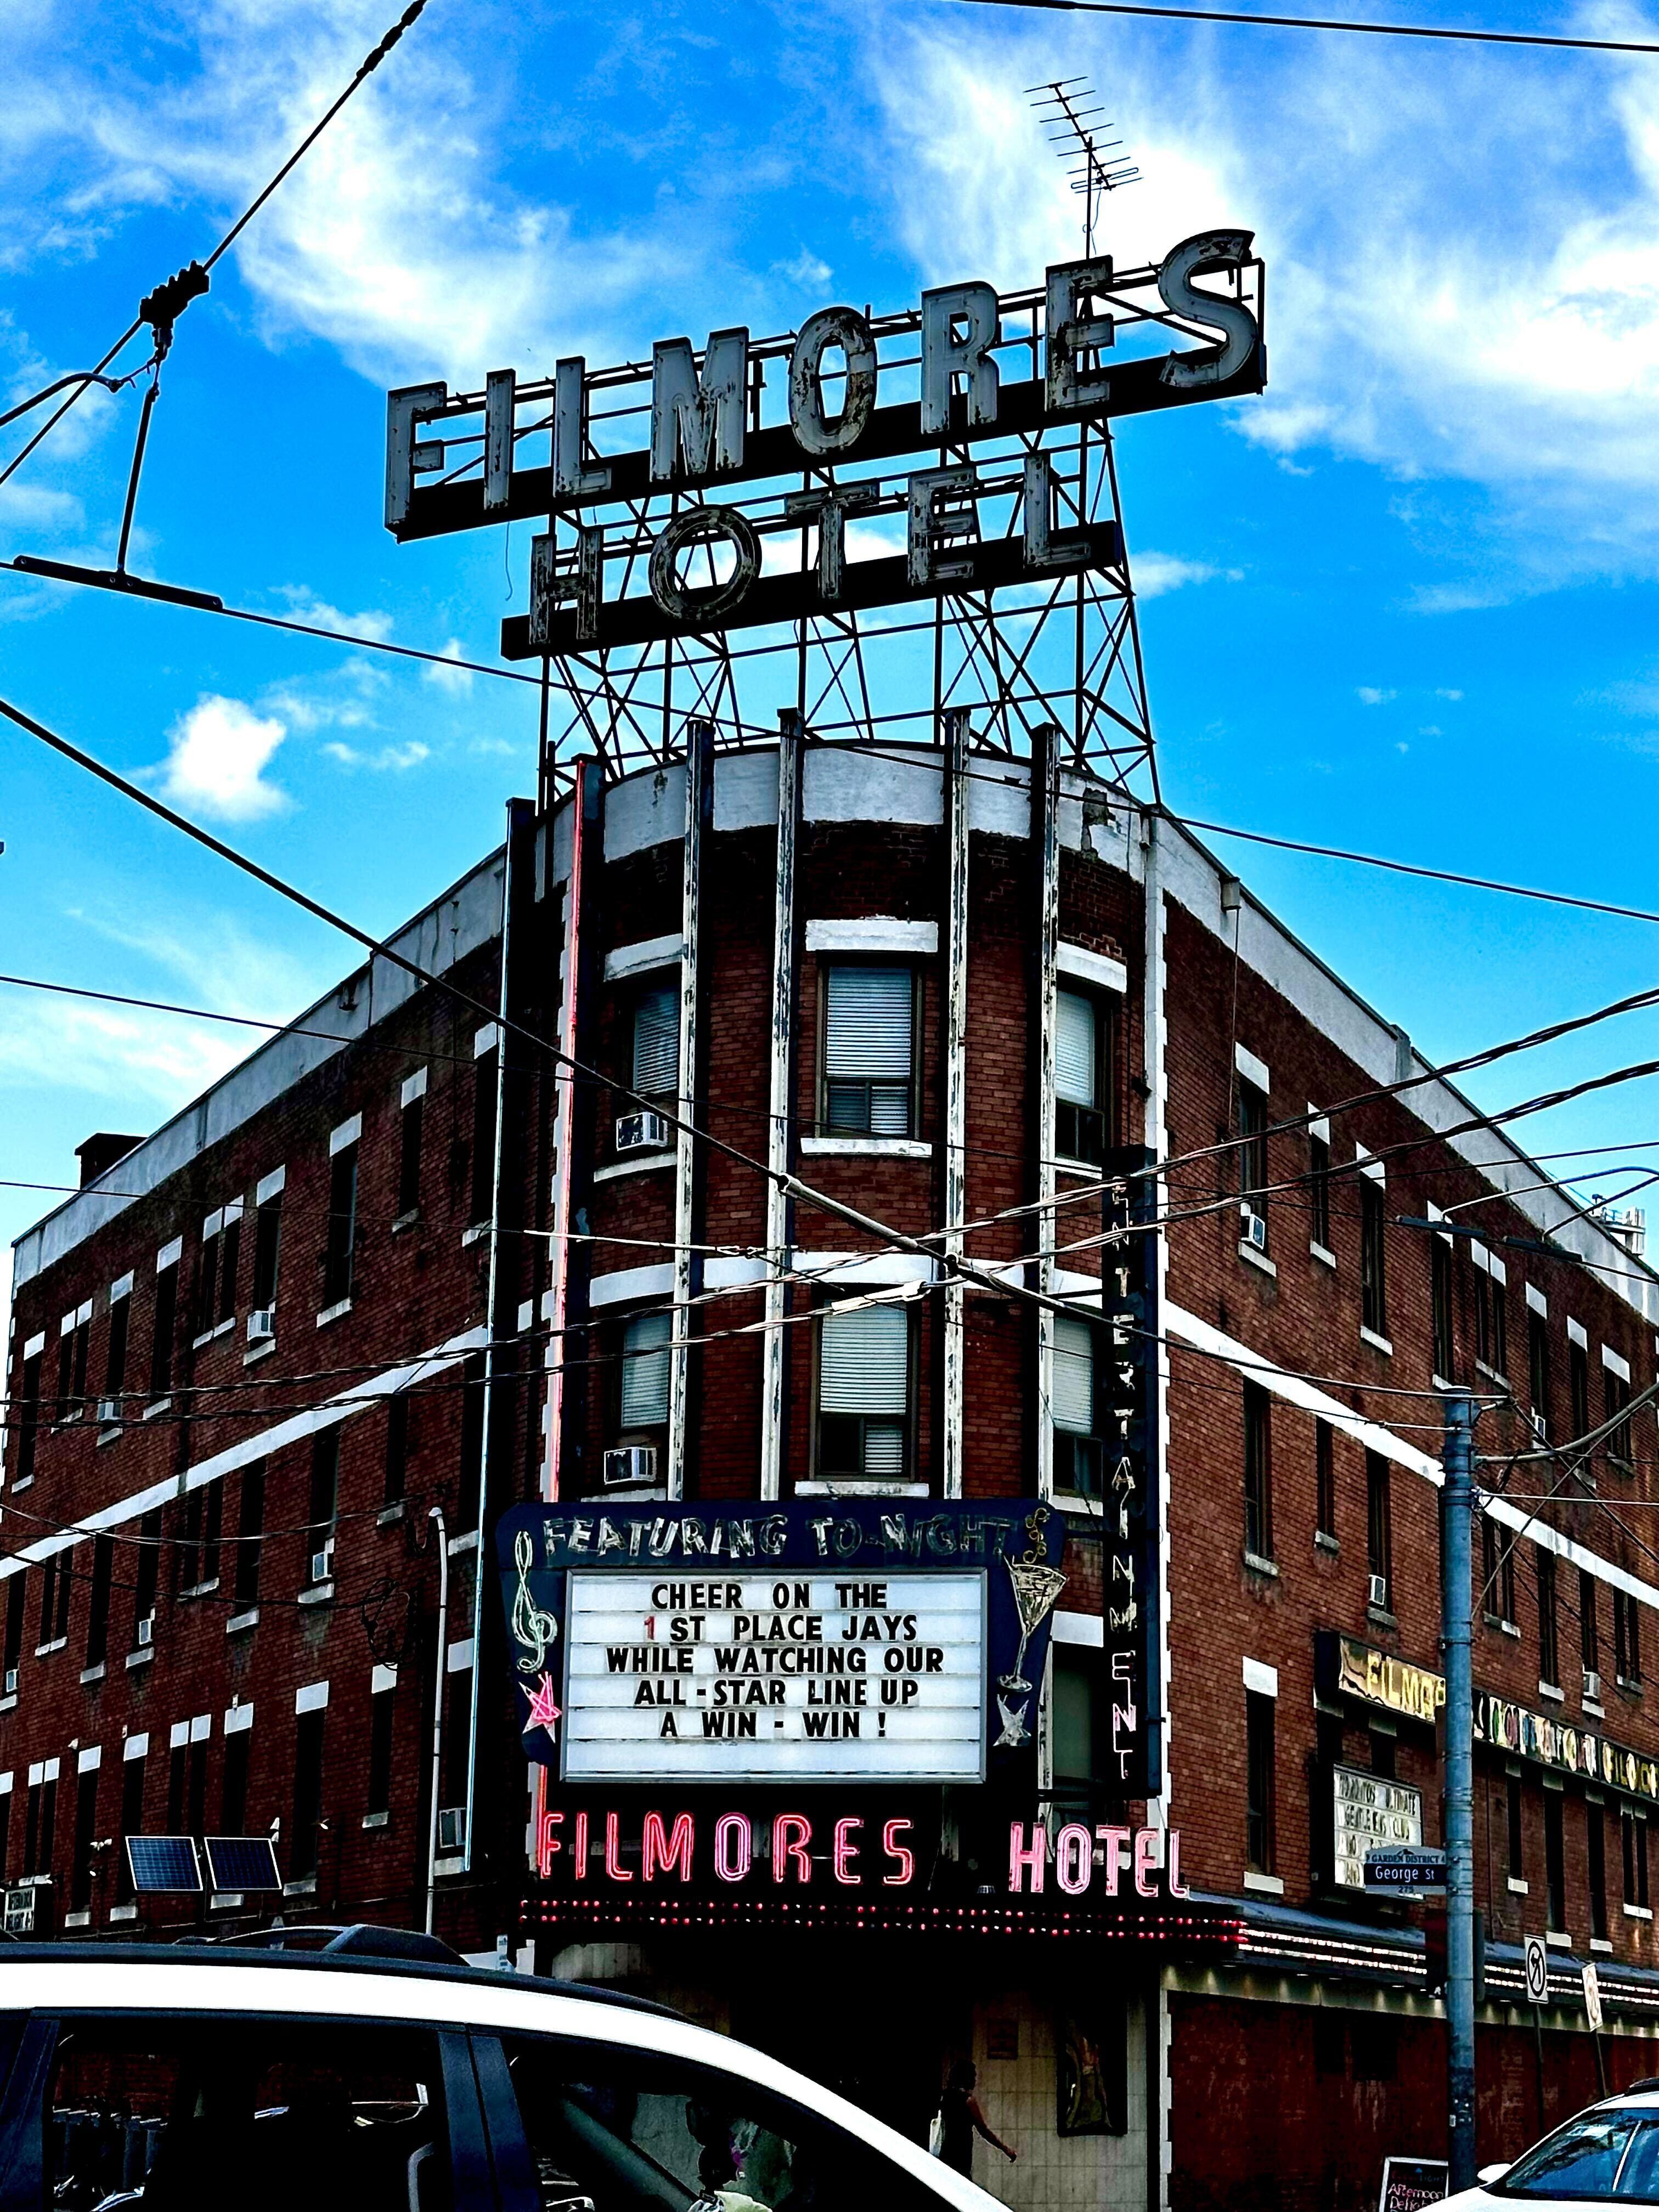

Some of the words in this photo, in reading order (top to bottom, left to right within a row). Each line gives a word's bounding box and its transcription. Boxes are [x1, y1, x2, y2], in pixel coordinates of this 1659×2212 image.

[385, 228, 1259, 529] FILMORES
[529, 450, 1096, 646] HOTEL
[543, 1514, 788, 1559] FEATURING
[651, 1583, 743, 1610] CHEER
[772, 1582, 810, 1610] ON
[834, 1583, 887, 1609] THE
[733, 1615, 822, 1641] PLACE
[842, 1614, 917, 1641] JAYS
[606, 1647, 694, 1673] WHILE
[714, 1647, 867, 1673] WATCHING
[884, 1647, 944, 1673] OUR
[808, 1679, 867, 1706] LINE
[881, 1679, 918, 1705] UP
[659, 1711, 678, 1738] A
[539, 1811, 917, 1886] FILMORES
[1008, 1820, 1190, 1899] HOTEL
[1372, 1854, 1403, 1864] GARDEN
[1406, 1854, 1440, 1864] DISTRICT
[1375, 1865, 1419, 1883] George
[1425, 1869, 1435, 1880] St
